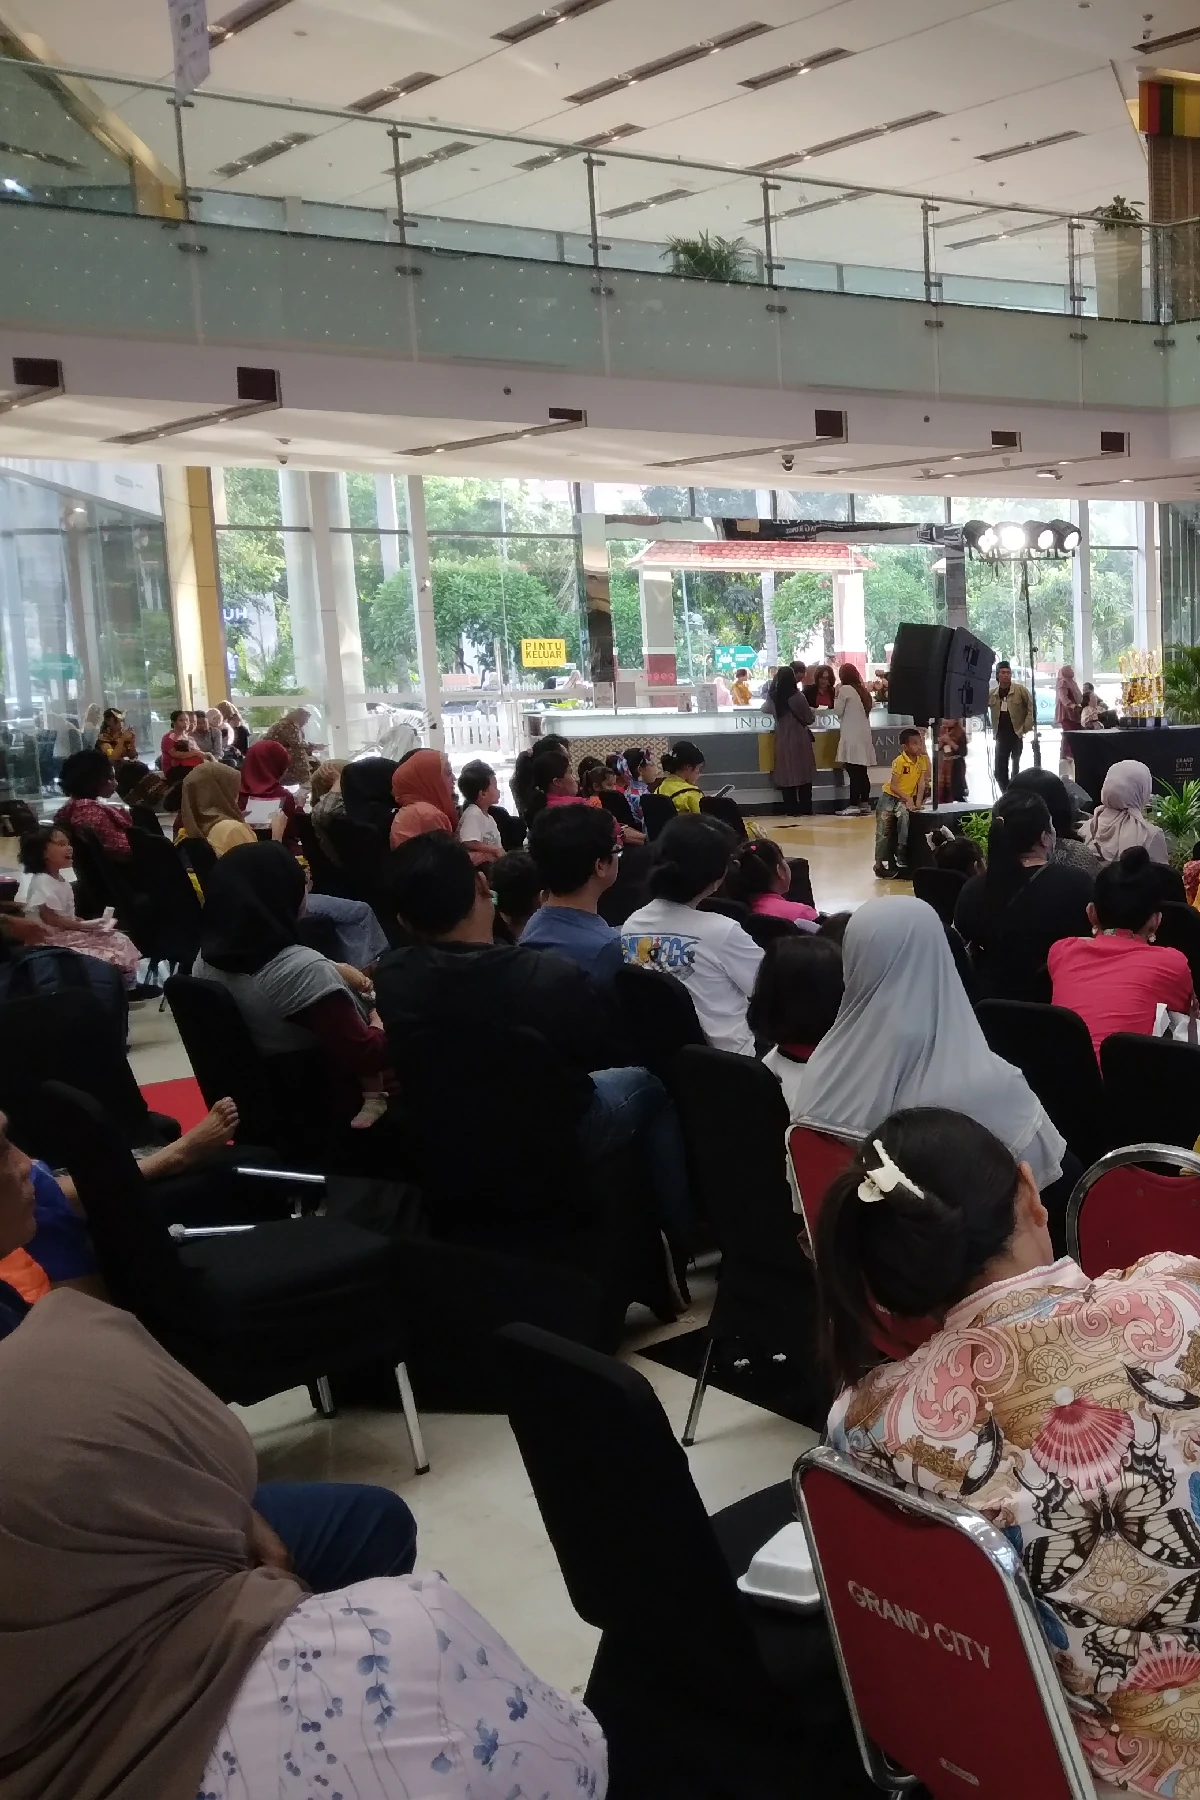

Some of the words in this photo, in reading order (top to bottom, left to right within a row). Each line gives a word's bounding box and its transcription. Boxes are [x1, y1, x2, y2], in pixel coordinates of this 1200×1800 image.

[525, 642, 562, 651] PINTU
[525, 650, 562, 659] KELUAR
[847, 1579, 930, 1640] GRAND
[933, 1622, 990, 1669] CITY
